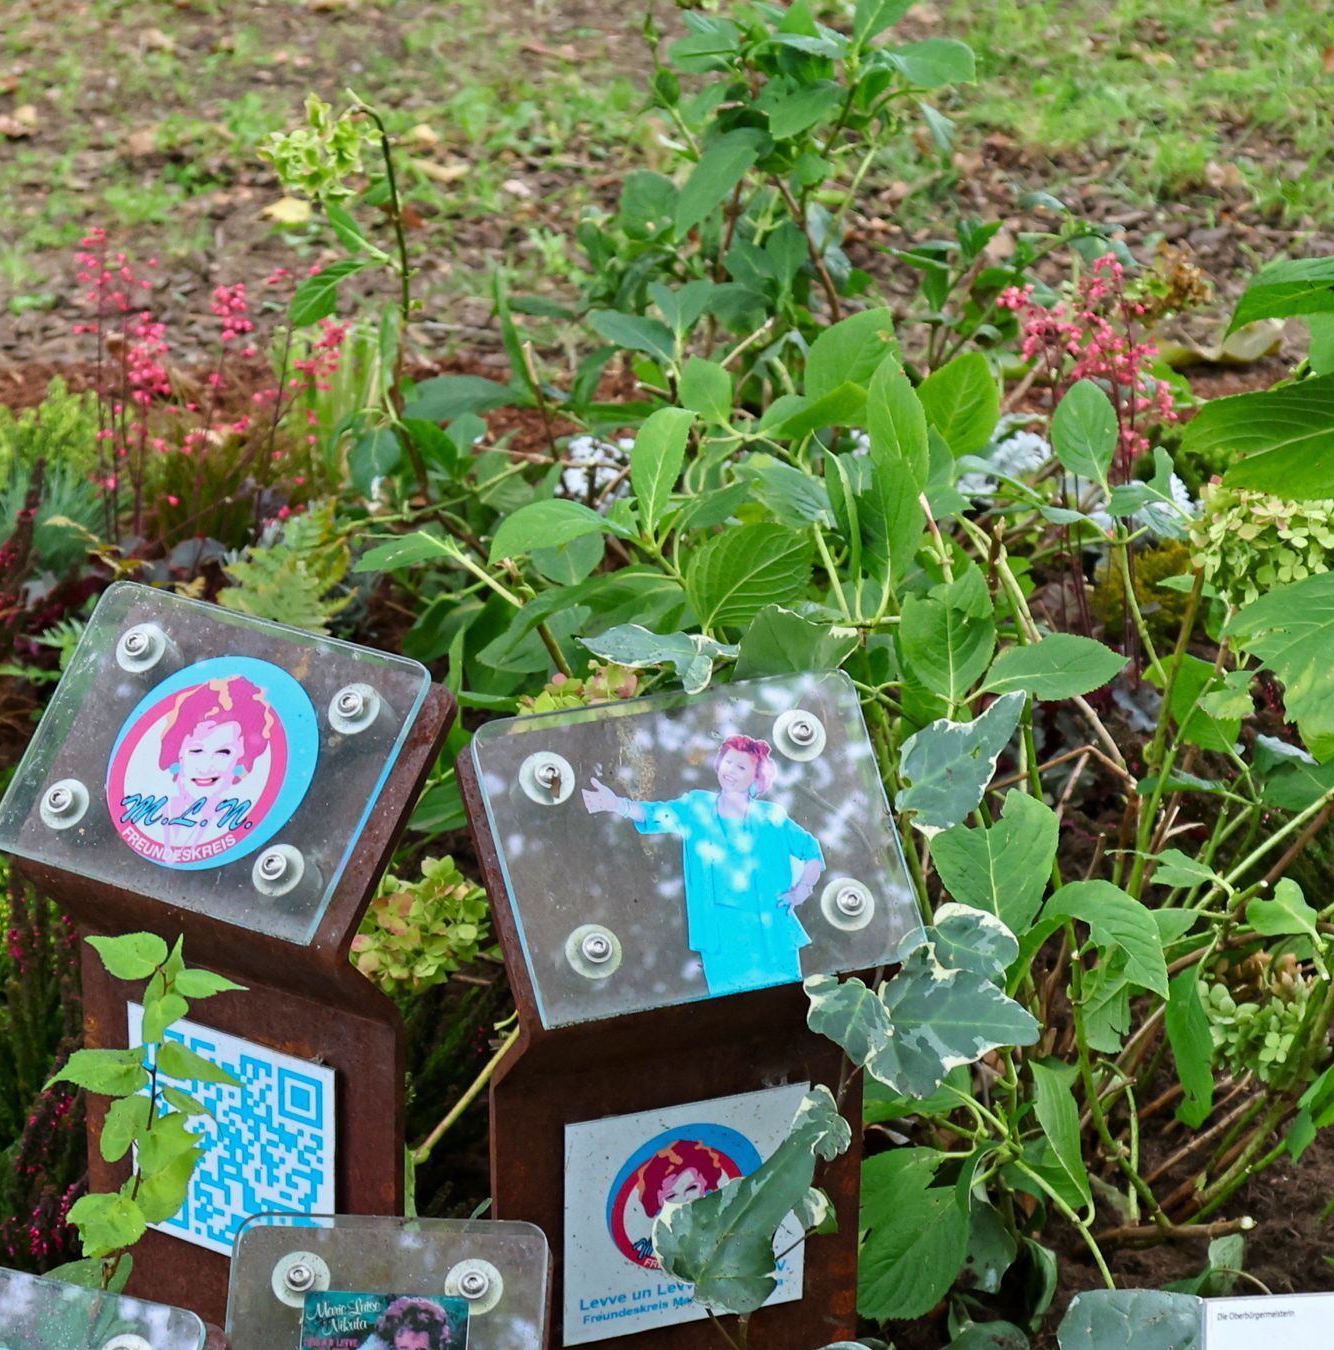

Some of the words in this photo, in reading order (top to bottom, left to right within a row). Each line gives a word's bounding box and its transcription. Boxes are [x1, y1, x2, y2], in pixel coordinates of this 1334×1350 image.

[121, 825, 237, 862] FREUNDESKREIS
[579, 1293, 628, 1312] Levve
[632, 1288, 652, 1301] un
[582, 1301, 669, 1325] Freundeskreis
[1217, 1311, 1228, 1321] Die
